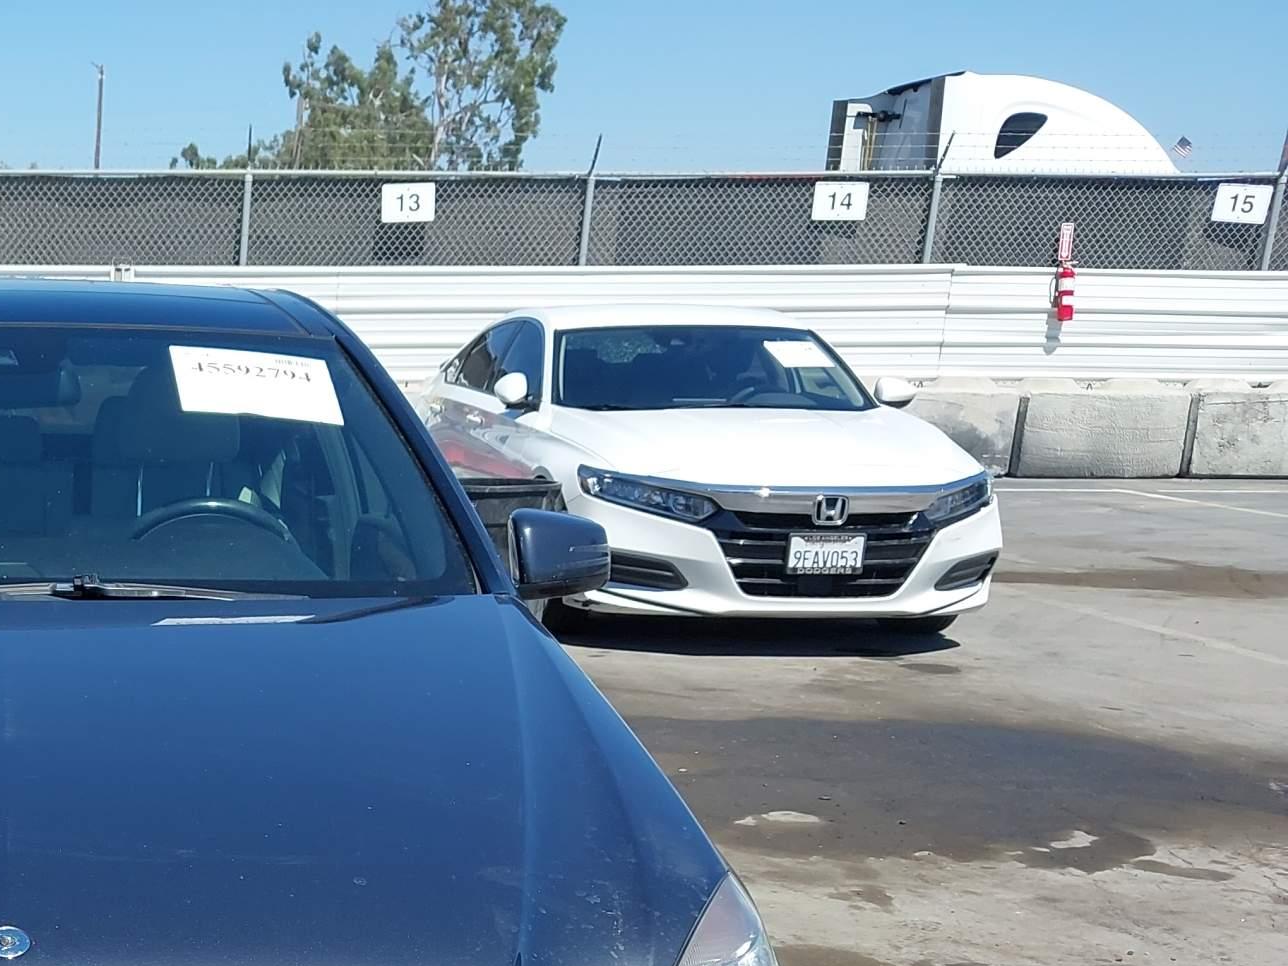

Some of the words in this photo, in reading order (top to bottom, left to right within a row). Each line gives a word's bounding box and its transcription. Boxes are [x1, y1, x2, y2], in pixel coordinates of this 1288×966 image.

[395, 193, 421, 212] 13
[827, 192, 853, 211] 14
[1229, 193, 1256, 214] 15
